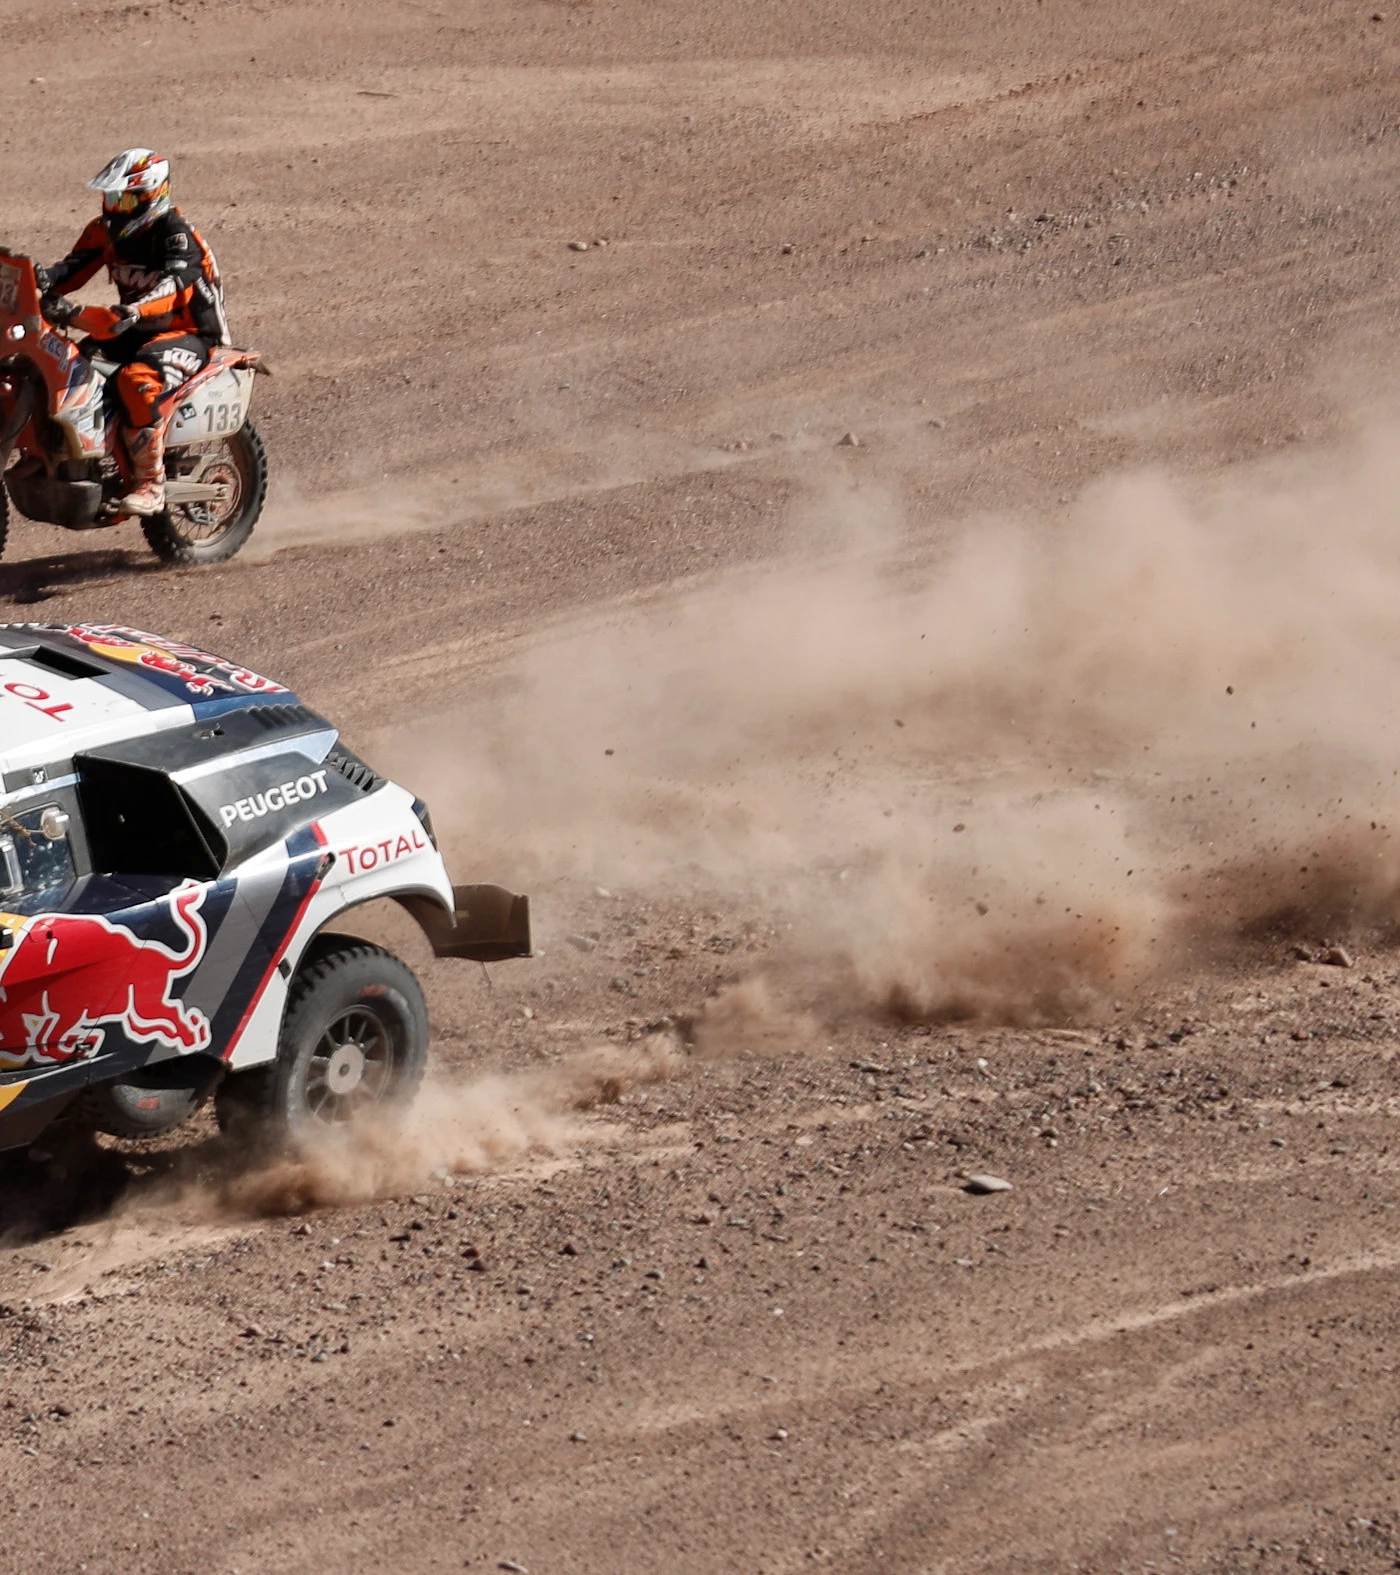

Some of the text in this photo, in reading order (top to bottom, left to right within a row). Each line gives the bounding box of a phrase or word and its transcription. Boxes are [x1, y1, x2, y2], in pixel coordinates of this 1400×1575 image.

[163, 347, 203, 374] KTM
[204, 402, 242, 433] 133
[219, 769, 330, 829] PEUGEOT
[339, 830, 426, 875] TOTAL
